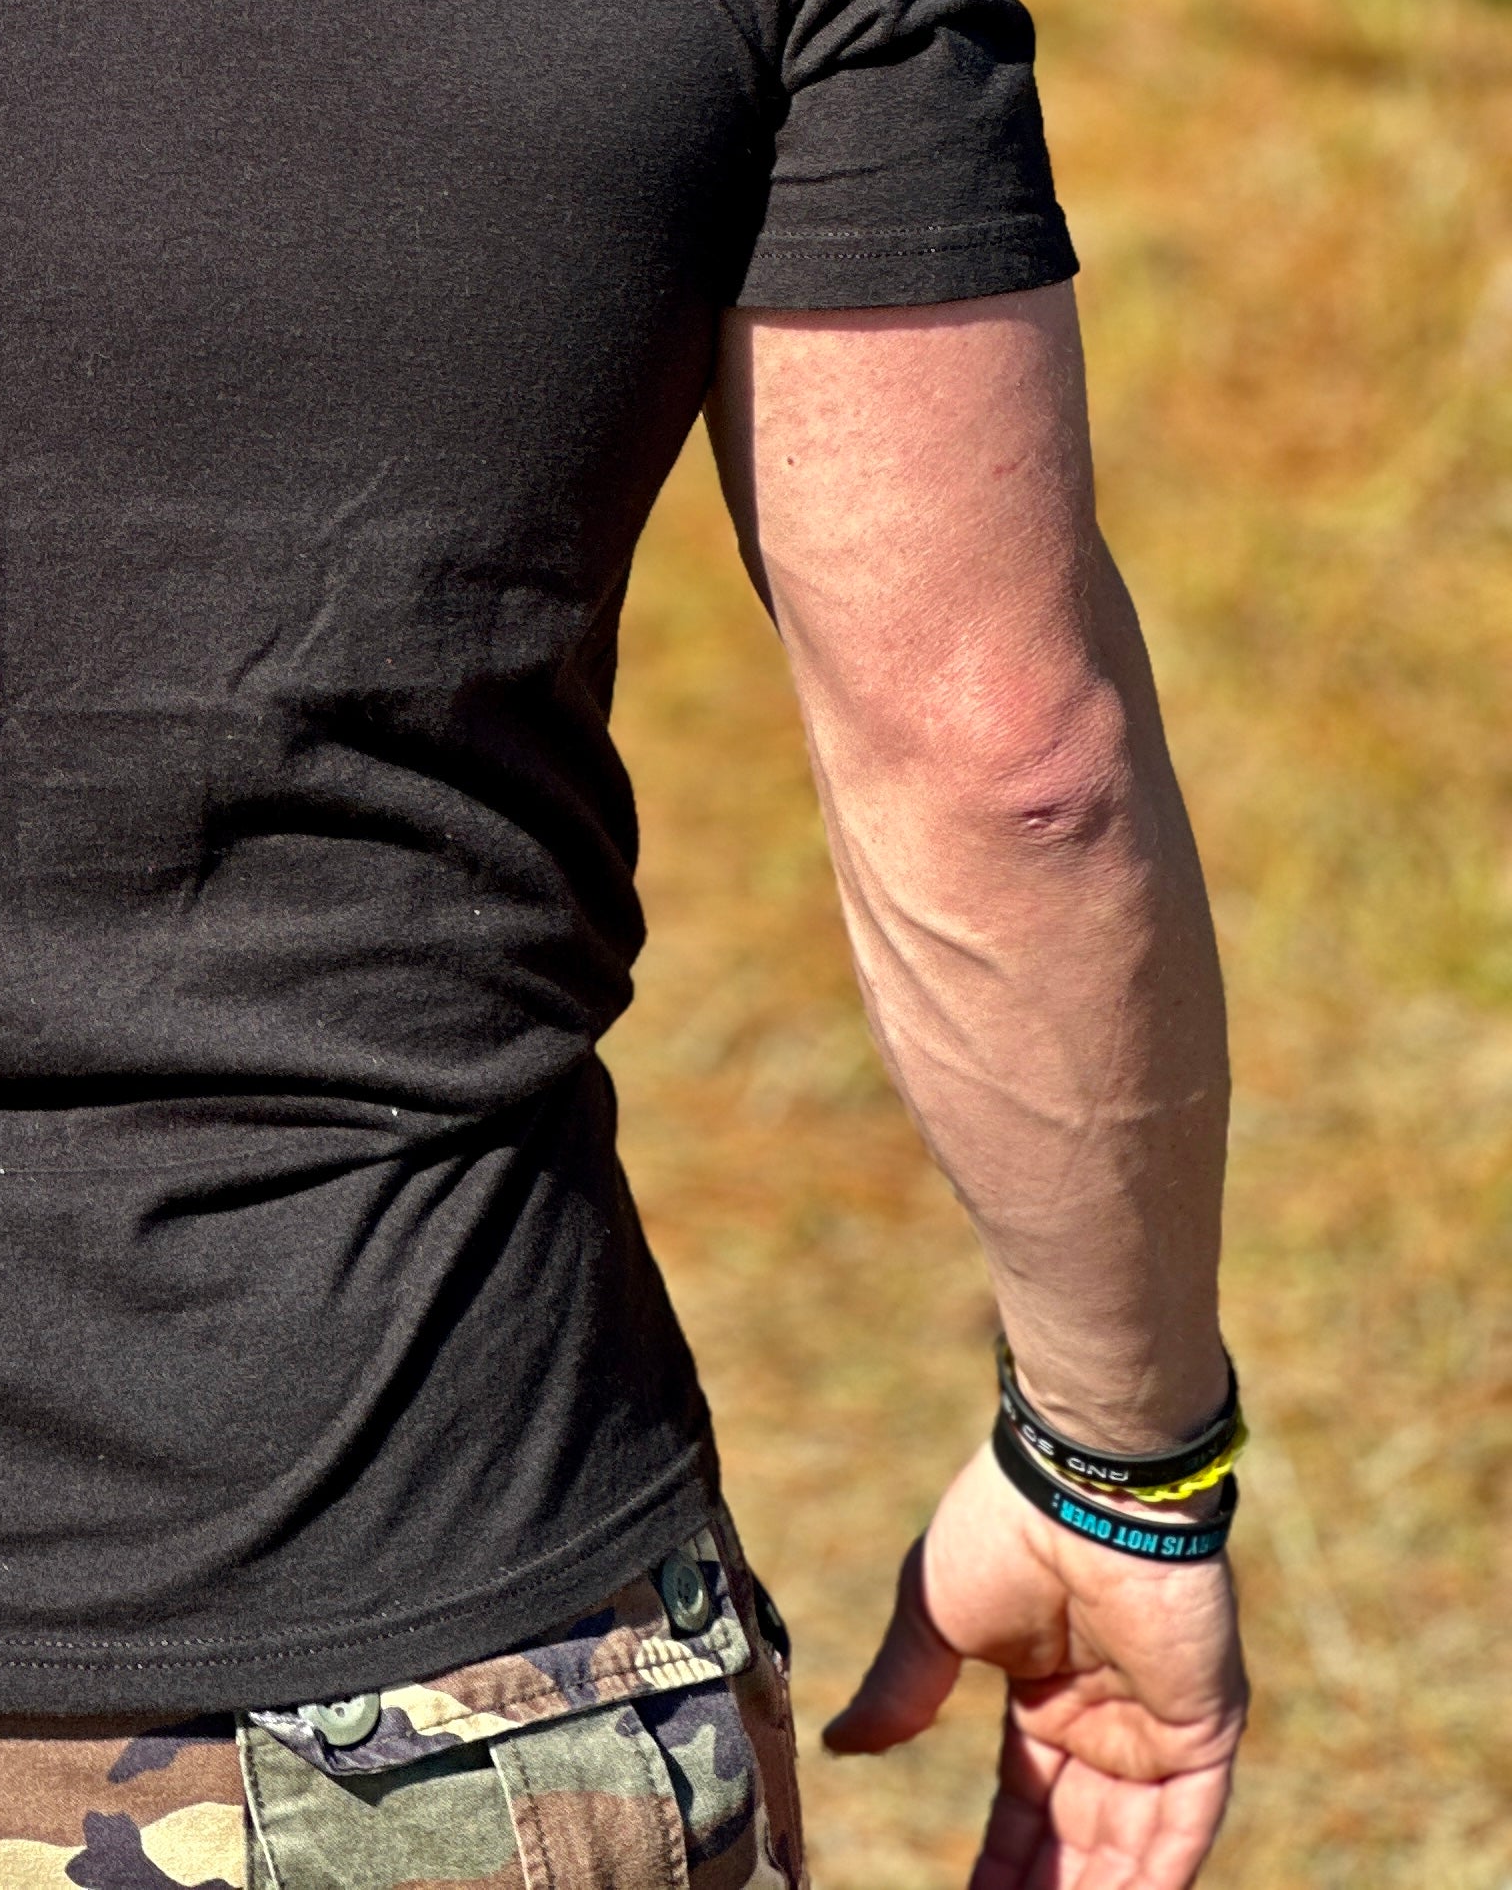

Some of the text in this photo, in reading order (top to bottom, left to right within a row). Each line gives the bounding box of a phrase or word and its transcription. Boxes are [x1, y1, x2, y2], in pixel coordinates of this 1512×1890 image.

[1066, 1456, 1130, 1482] AND
[1113, 1525, 1159, 1553] NOT
[1160, 1534, 1185, 1556] IS
